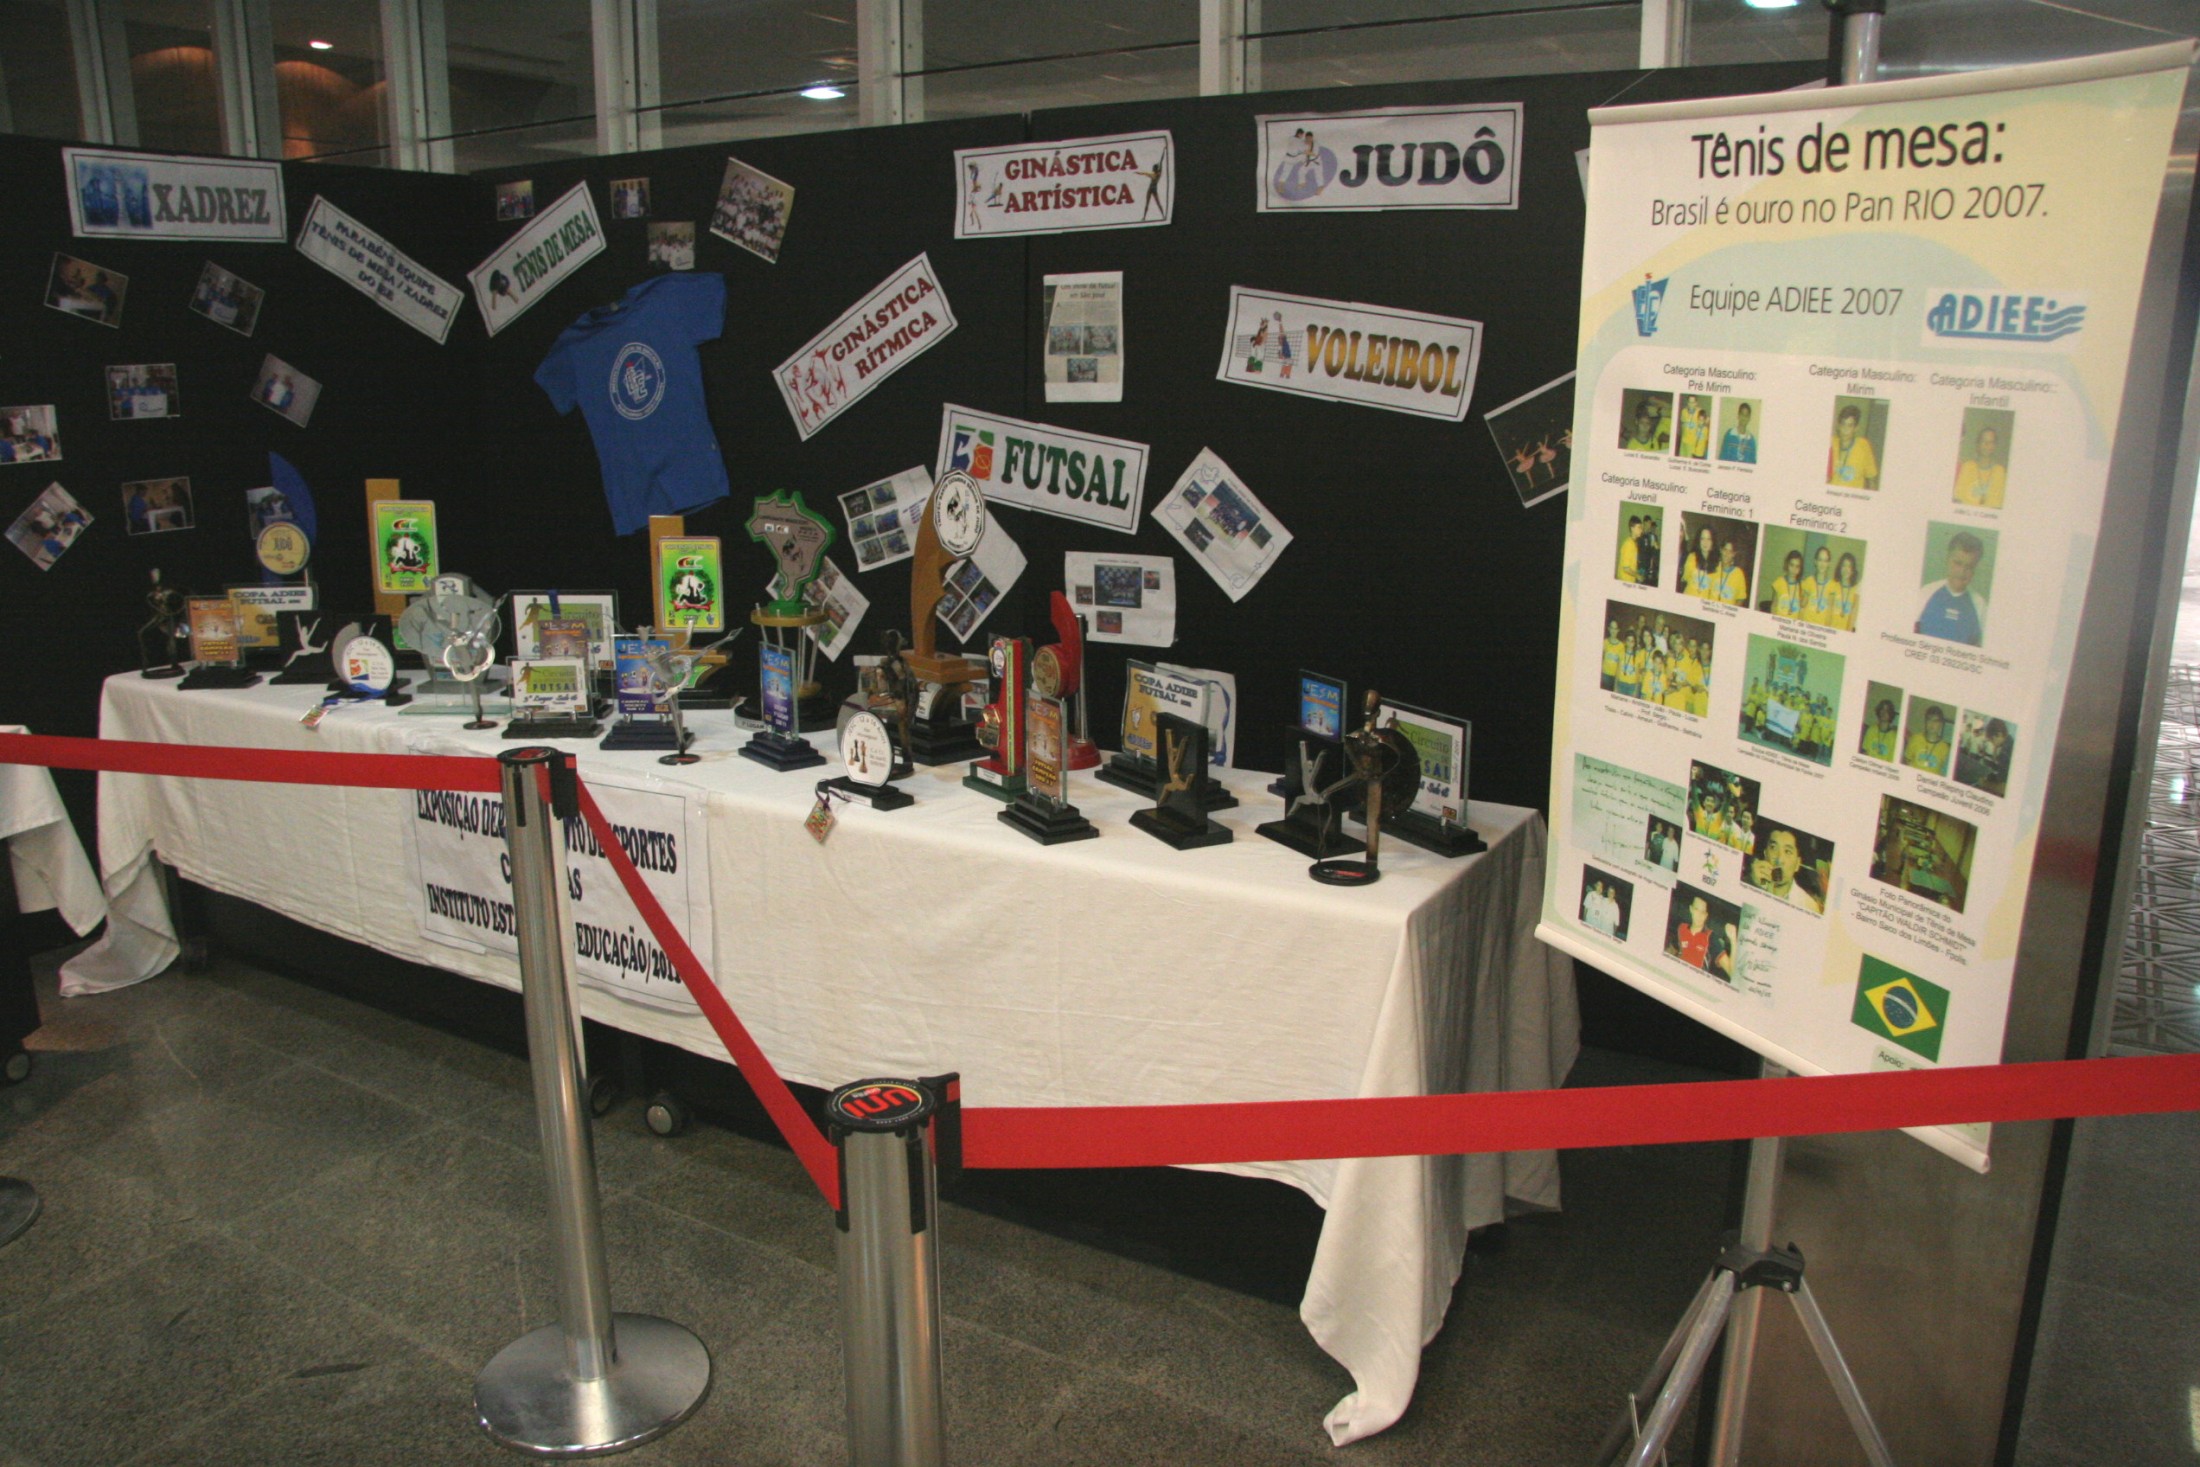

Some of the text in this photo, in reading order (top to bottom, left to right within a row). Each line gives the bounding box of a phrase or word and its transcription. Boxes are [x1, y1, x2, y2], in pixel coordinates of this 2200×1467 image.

[1339, 126, 1505, 188] JUDÔ
[1692, 119, 2005, 179] Tênis de mesa:
[1005, 149, 1138, 180] GINÁSTICA
[152, 183, 271, 225] XADREZ
[1004, 183, 1134, 213] ARTÍSTICA
[1651, 184, 2048, 226] Brasil é ouro no Pan RIO 2007.
[335, 221, 436, 296] PARABÉNS EQUIPE
[512, 209, 596, 293] TÊNIS DE MESA
[311, 221, 346, 251] TÊNIS
[348, 246, 365, 264] DE
[366, 258, 396, 286] MESA
[404, 284, 448, 320] XADREZ
[358, 270, 376, 287] DO
[1689, 284, 1903, 317] Equipe ADIEE 2007
[831, 276, 935, 362] GINÁSTICA
[854, 311, 938, 379] RÍTMICA
[1306, 324, 1462, 398] VOLEIBOL
[1663, 364, 1757, 382] Categoria Masculino:
[1808, 364, 1917, 383] Categoria Masculino:
[1688, 379, 1731, 394] Pré Mirim
[1846, 383, 1875, 396] Mirim
[1930, 372, 1986, 391] Categoria
[1970, 393, 2010, 408] Infantil
[1001, 435, 1130, 510] FUTSAL
[1601, 472, 1688, 494] Categoria Masculino:
[1627, 490, 1657, 503] Juvenil
[1701, 501, 1754, 519] Feminino: 1
[1706, 487, 1751, 504] Categoria
[1794, 499, 1842, 517] Categoria
[1789, 513, 1848, 534] Feminino: 2
[1880, 632, 1916, 647] Professor
[1946, 646, 1977, 661] Roberto
[1134, 673, 1198, 698] COPA ADIEE
[1139, 684, 1178, 703] FUTSAL
[1303, 681, 1339, 702] JESM
[427, 883, 491, 929] INSTITUTO
[1850, 888, 1976, 947] Ginásio Municipal de Tênis de Mesa
[1880, 888, 1951, 923] Foto Panorâmica do
[1856, 911, 1877, 926] Bairro
[1879, 920, 1897, 935] Saco
[1898, 930, 1912, 941] dos
[1914, 935, 1939, 952] Limões
[1897, 915, 1928, 936] WALDIR
[1878, 1050, 1904, 1069] Apoio:
